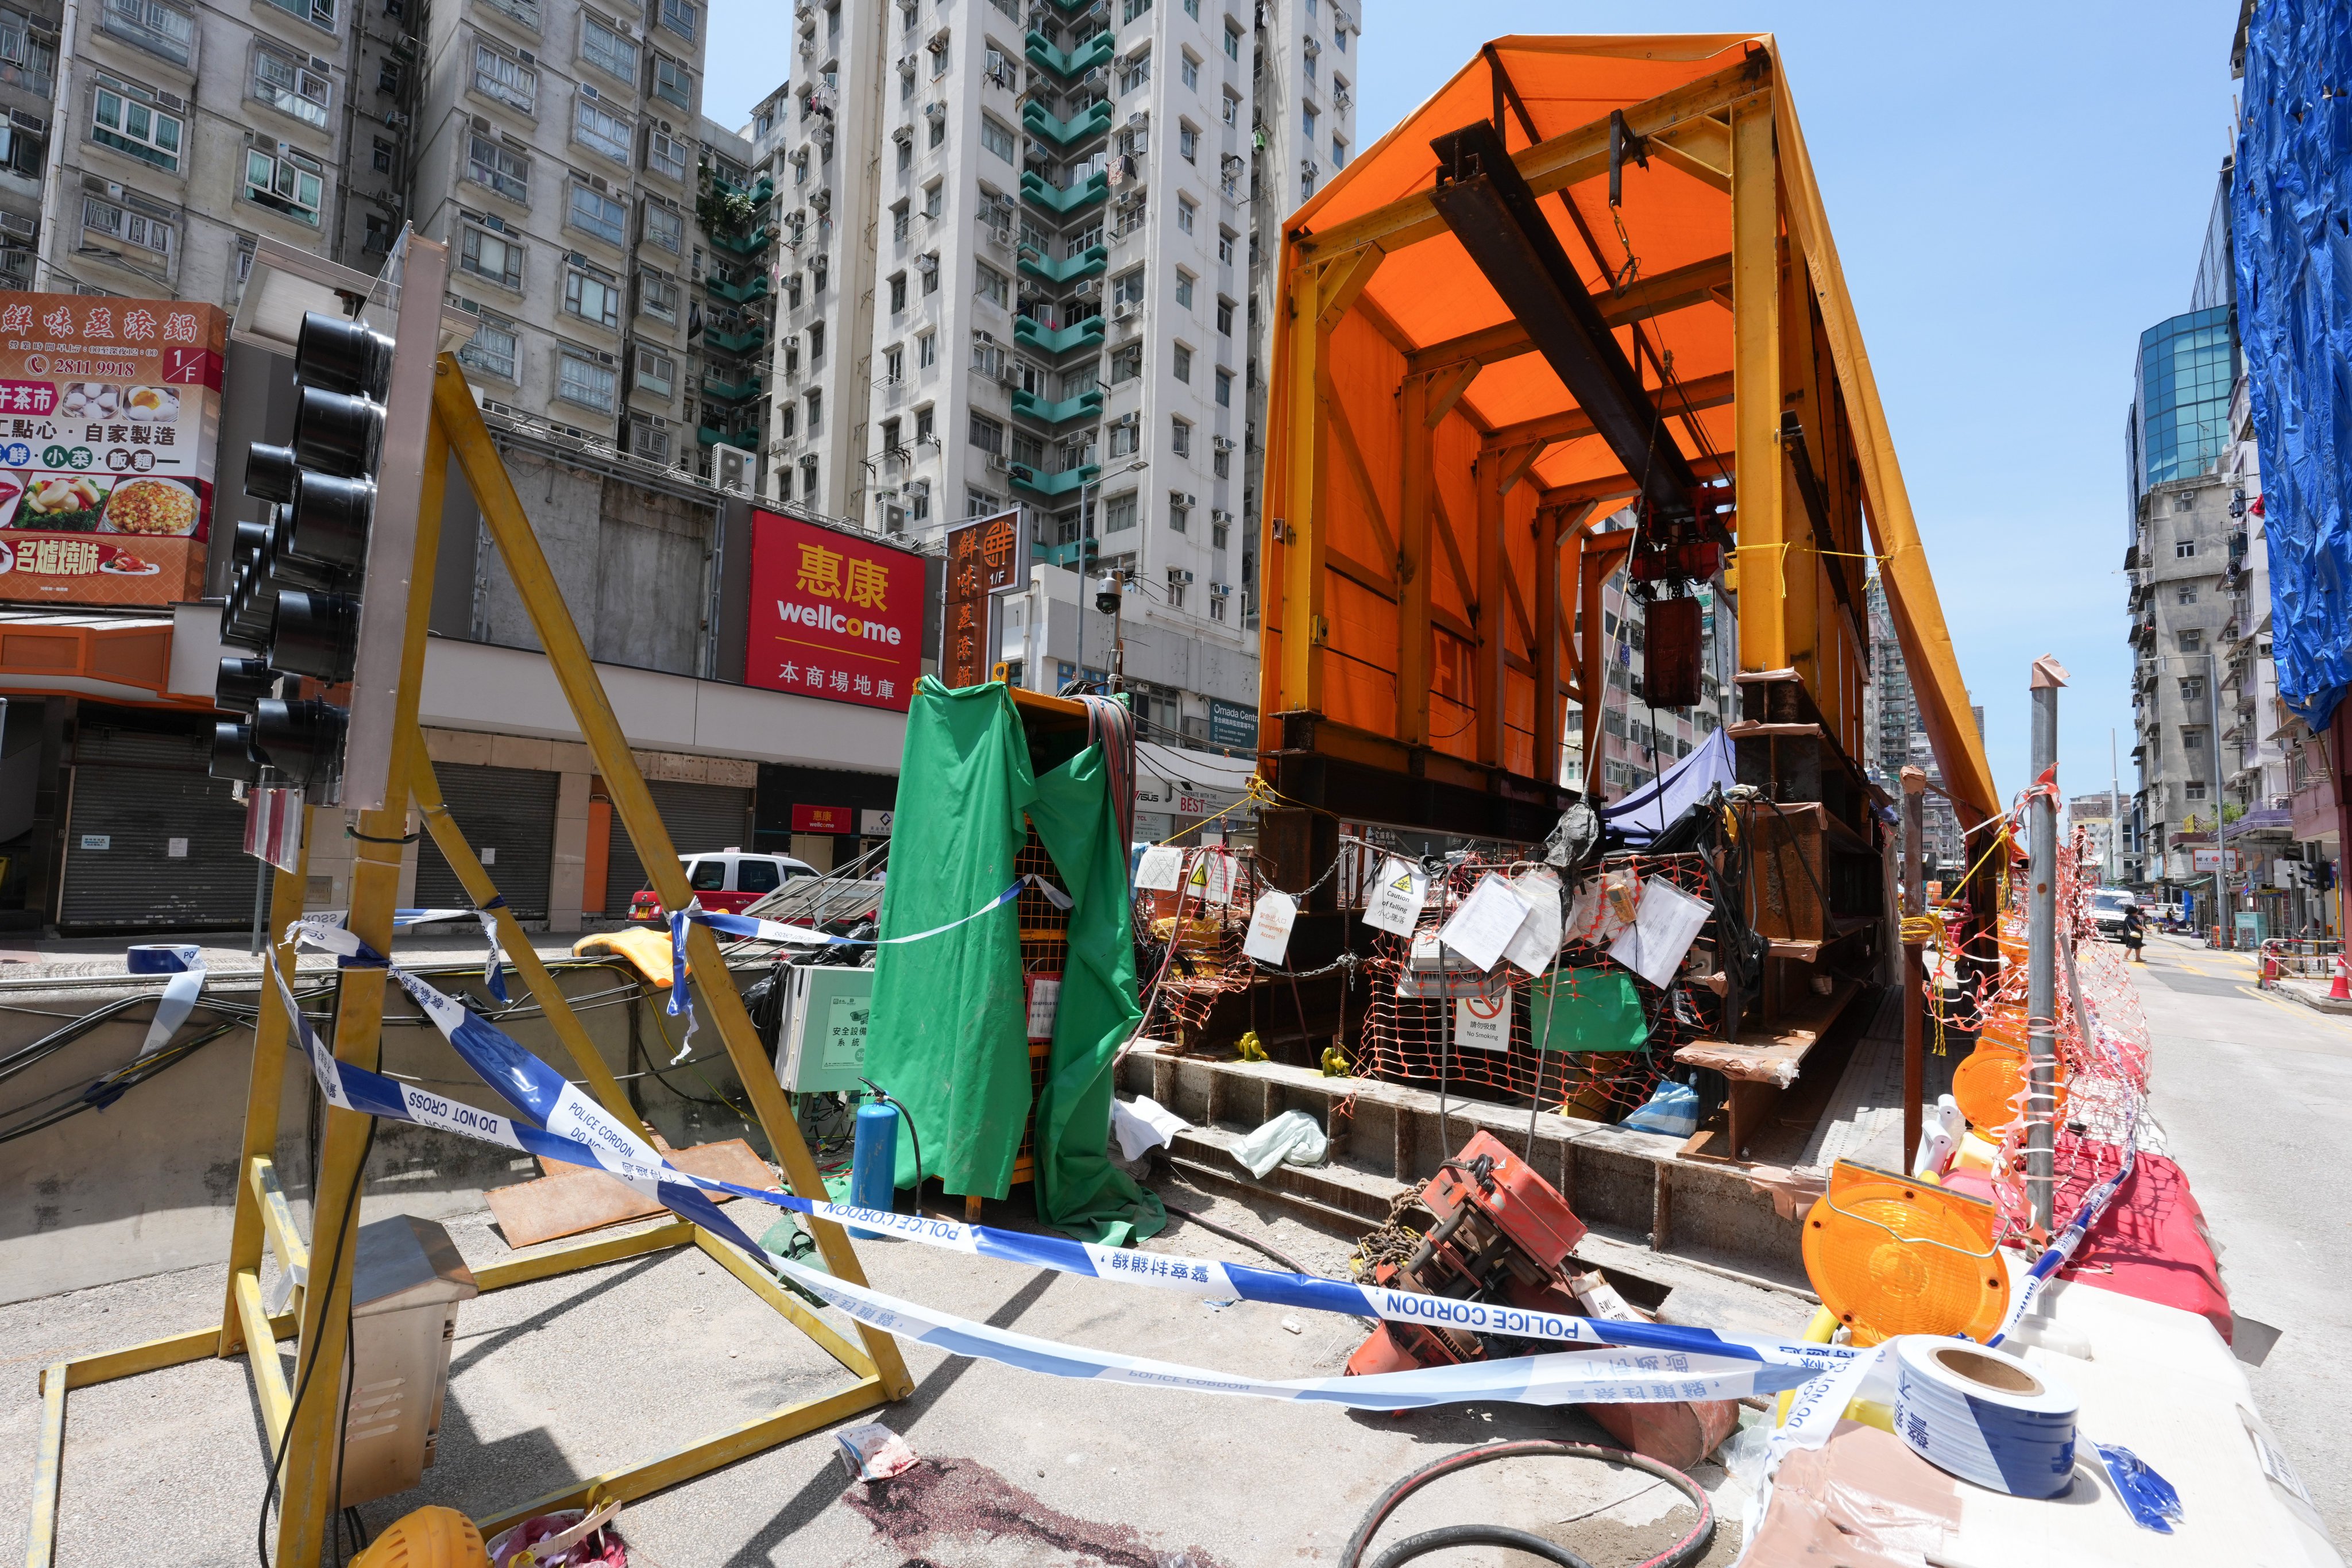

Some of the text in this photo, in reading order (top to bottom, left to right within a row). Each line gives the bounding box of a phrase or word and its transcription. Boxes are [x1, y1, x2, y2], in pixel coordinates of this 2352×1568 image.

[1, 304, 198, 342] 鮮味蒸滾鍋
[55, 358, 135, 377] 2811 9918
[16, 540, 99, 575] 名爐燒味
[795, 542, 890, 612] 惠康
[990, 571, 1005, 586] 1/F
[956, 528, 978, 688] 鮮味蒸滾鍋
[777, 600, 901, 646] wellcome
[778, 660, 895, 700] 本商場地庫
[1214, 704, 1239, 719] Omada
[1136, 793, 1159, 802] ASUS
[1180, 797, 1205, 813] BEST
[813, 810, 832, 821] 惠康
[1387, 890, 1410, 902] Caution
[1390, 902, 1408, 914] falling
[1260, 912, 1287, 924] 緊急出入口
[1377, 909, 1406, 924] 小心墜落
[1258, 922, 1283, 933] Emergency
[1261, 932, 1276, 940] Access
[833, 1027, 867, 1036] 安全設備
[1470, 1021, 1496, 1030] 請勿吸煙
[837, 1038, 859, 1047] 系統
[1476, 1032, 1498, 1041] Smoking
[408, 1091, 498, 1134] DO NOT CROSS
[569, 1102, 635, 1158] POLICE CORDON
[570, 1127, 585, 1144] DO
[897, 1216, 963, 1241] POLICE
[1493, 1310, 1578, 1339] POLICE
[1788, 1408, 1811, 1428] DO
